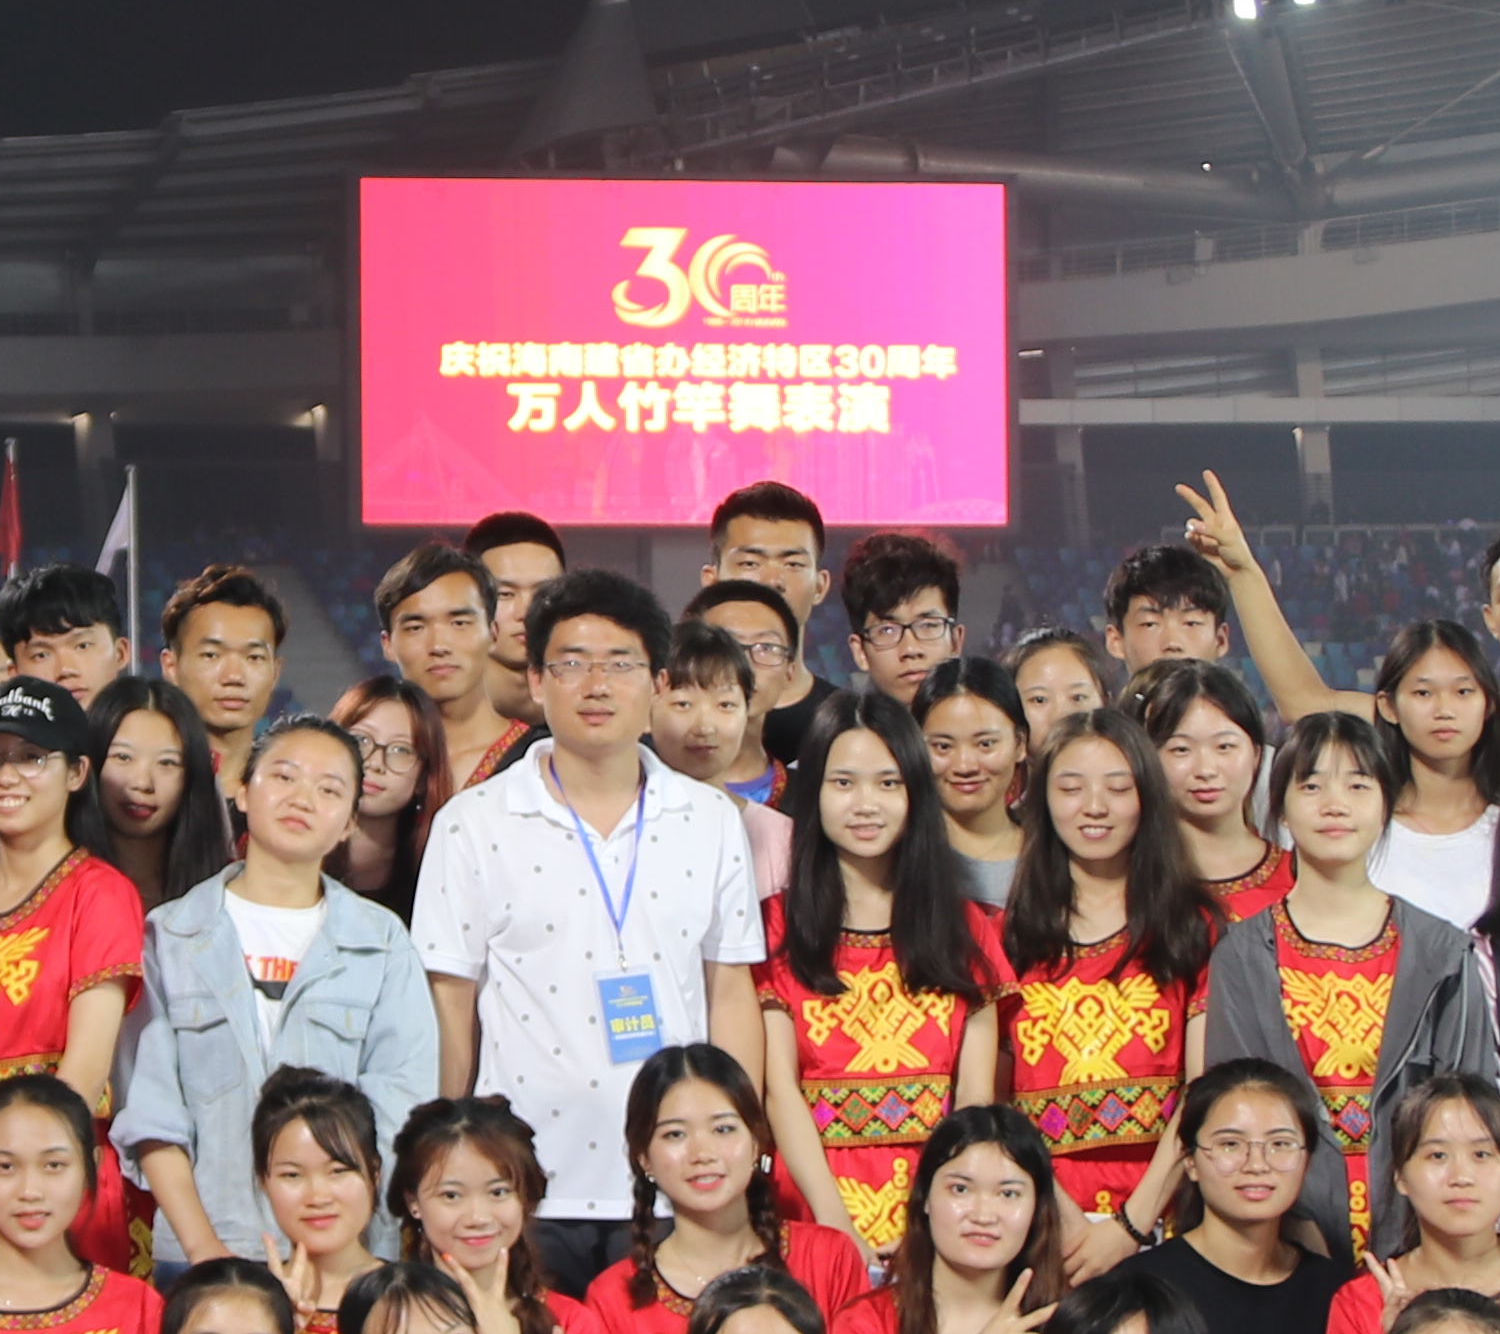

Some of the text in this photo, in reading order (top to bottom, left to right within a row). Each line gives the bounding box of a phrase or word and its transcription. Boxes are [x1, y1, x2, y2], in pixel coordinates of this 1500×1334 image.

[730, 284, 786, 313] 周年
[439, 341, 957, 379] 庆祝海南建省办经济特区30周年
[506, 380, 890, 433] 万人竹竿舞表演
